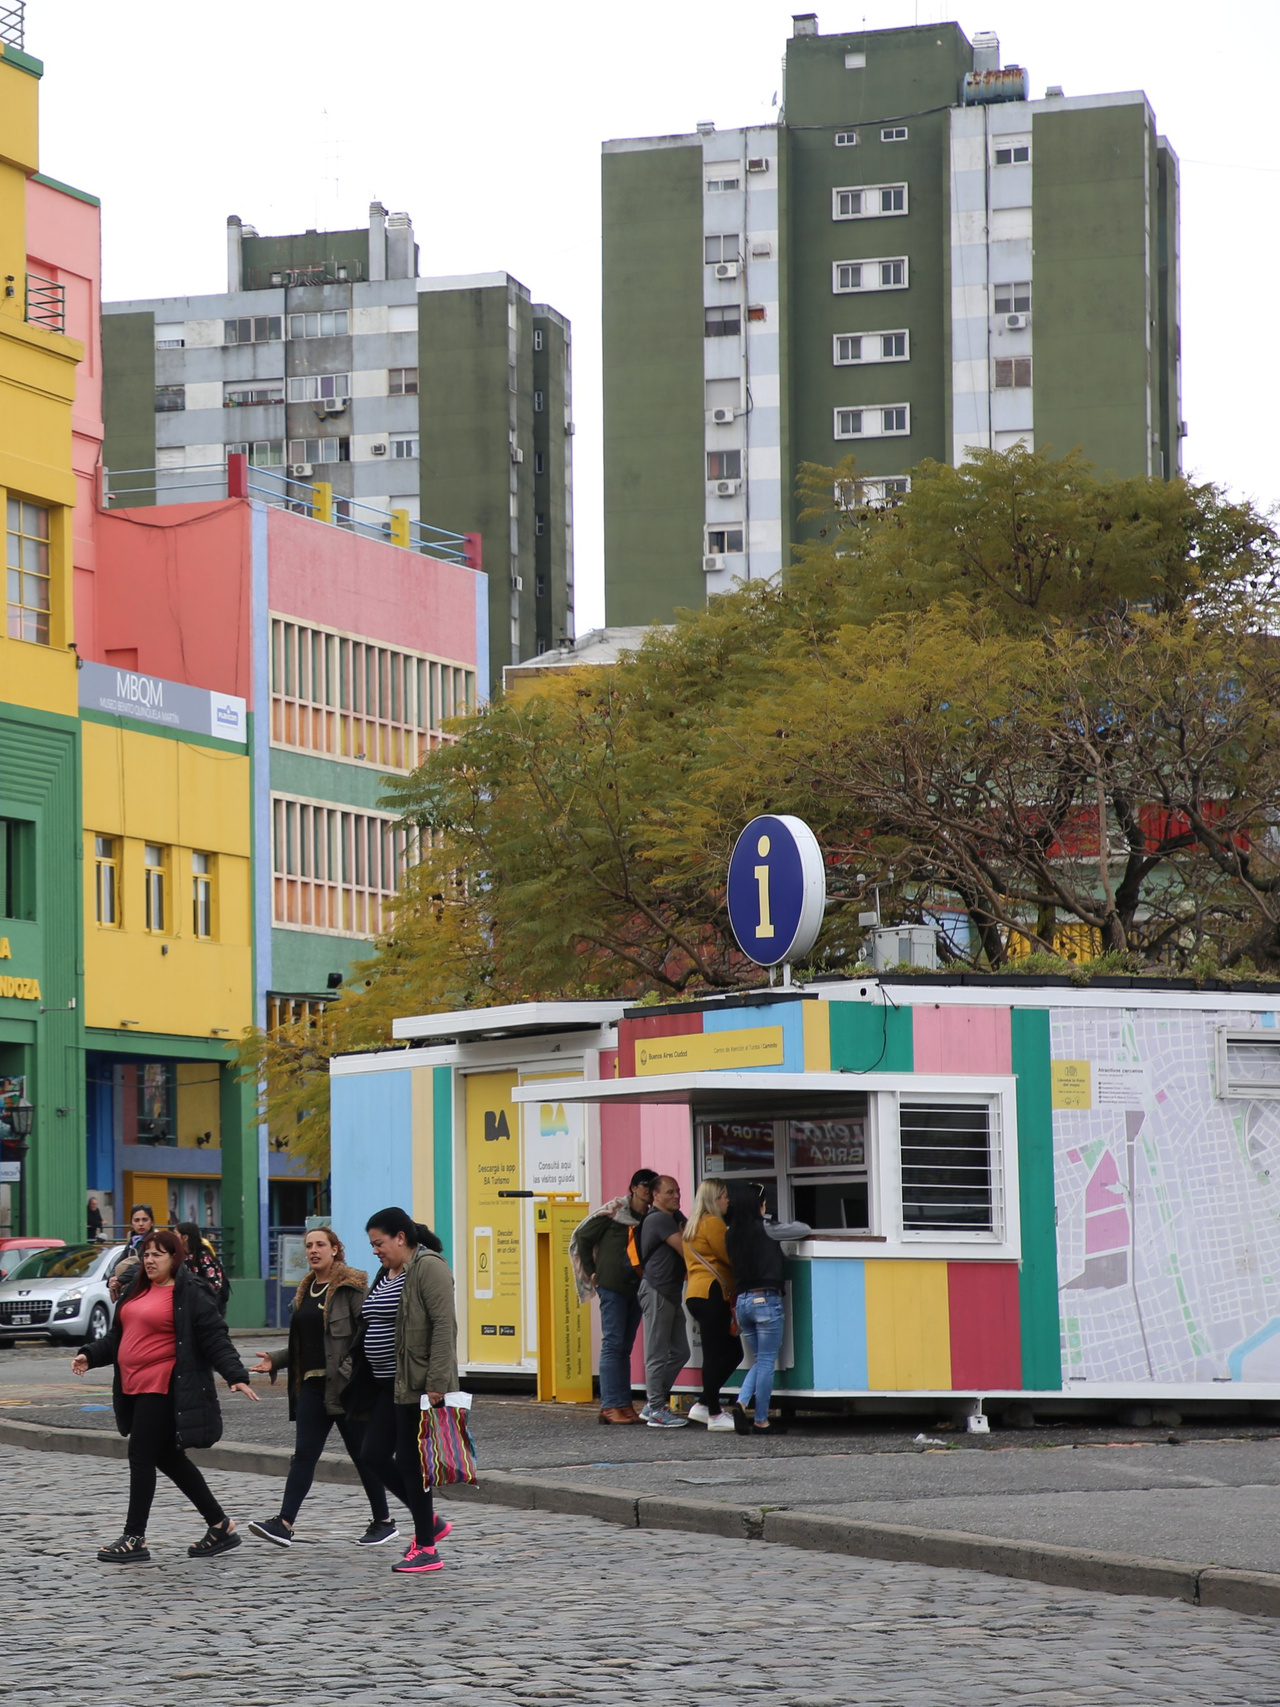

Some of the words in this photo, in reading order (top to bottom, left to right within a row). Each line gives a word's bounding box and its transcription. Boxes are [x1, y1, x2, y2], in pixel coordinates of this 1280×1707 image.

[99, 697, 117, 709] MUSEO
[116, 671, 163, 708] MBQM
[649, 1052, 663, 1060] Buenos
[663, 1051, 673, 1059] Aires
[484, 1109, 511, 1142] BA
[540, 1102, 569, 1138] BA
